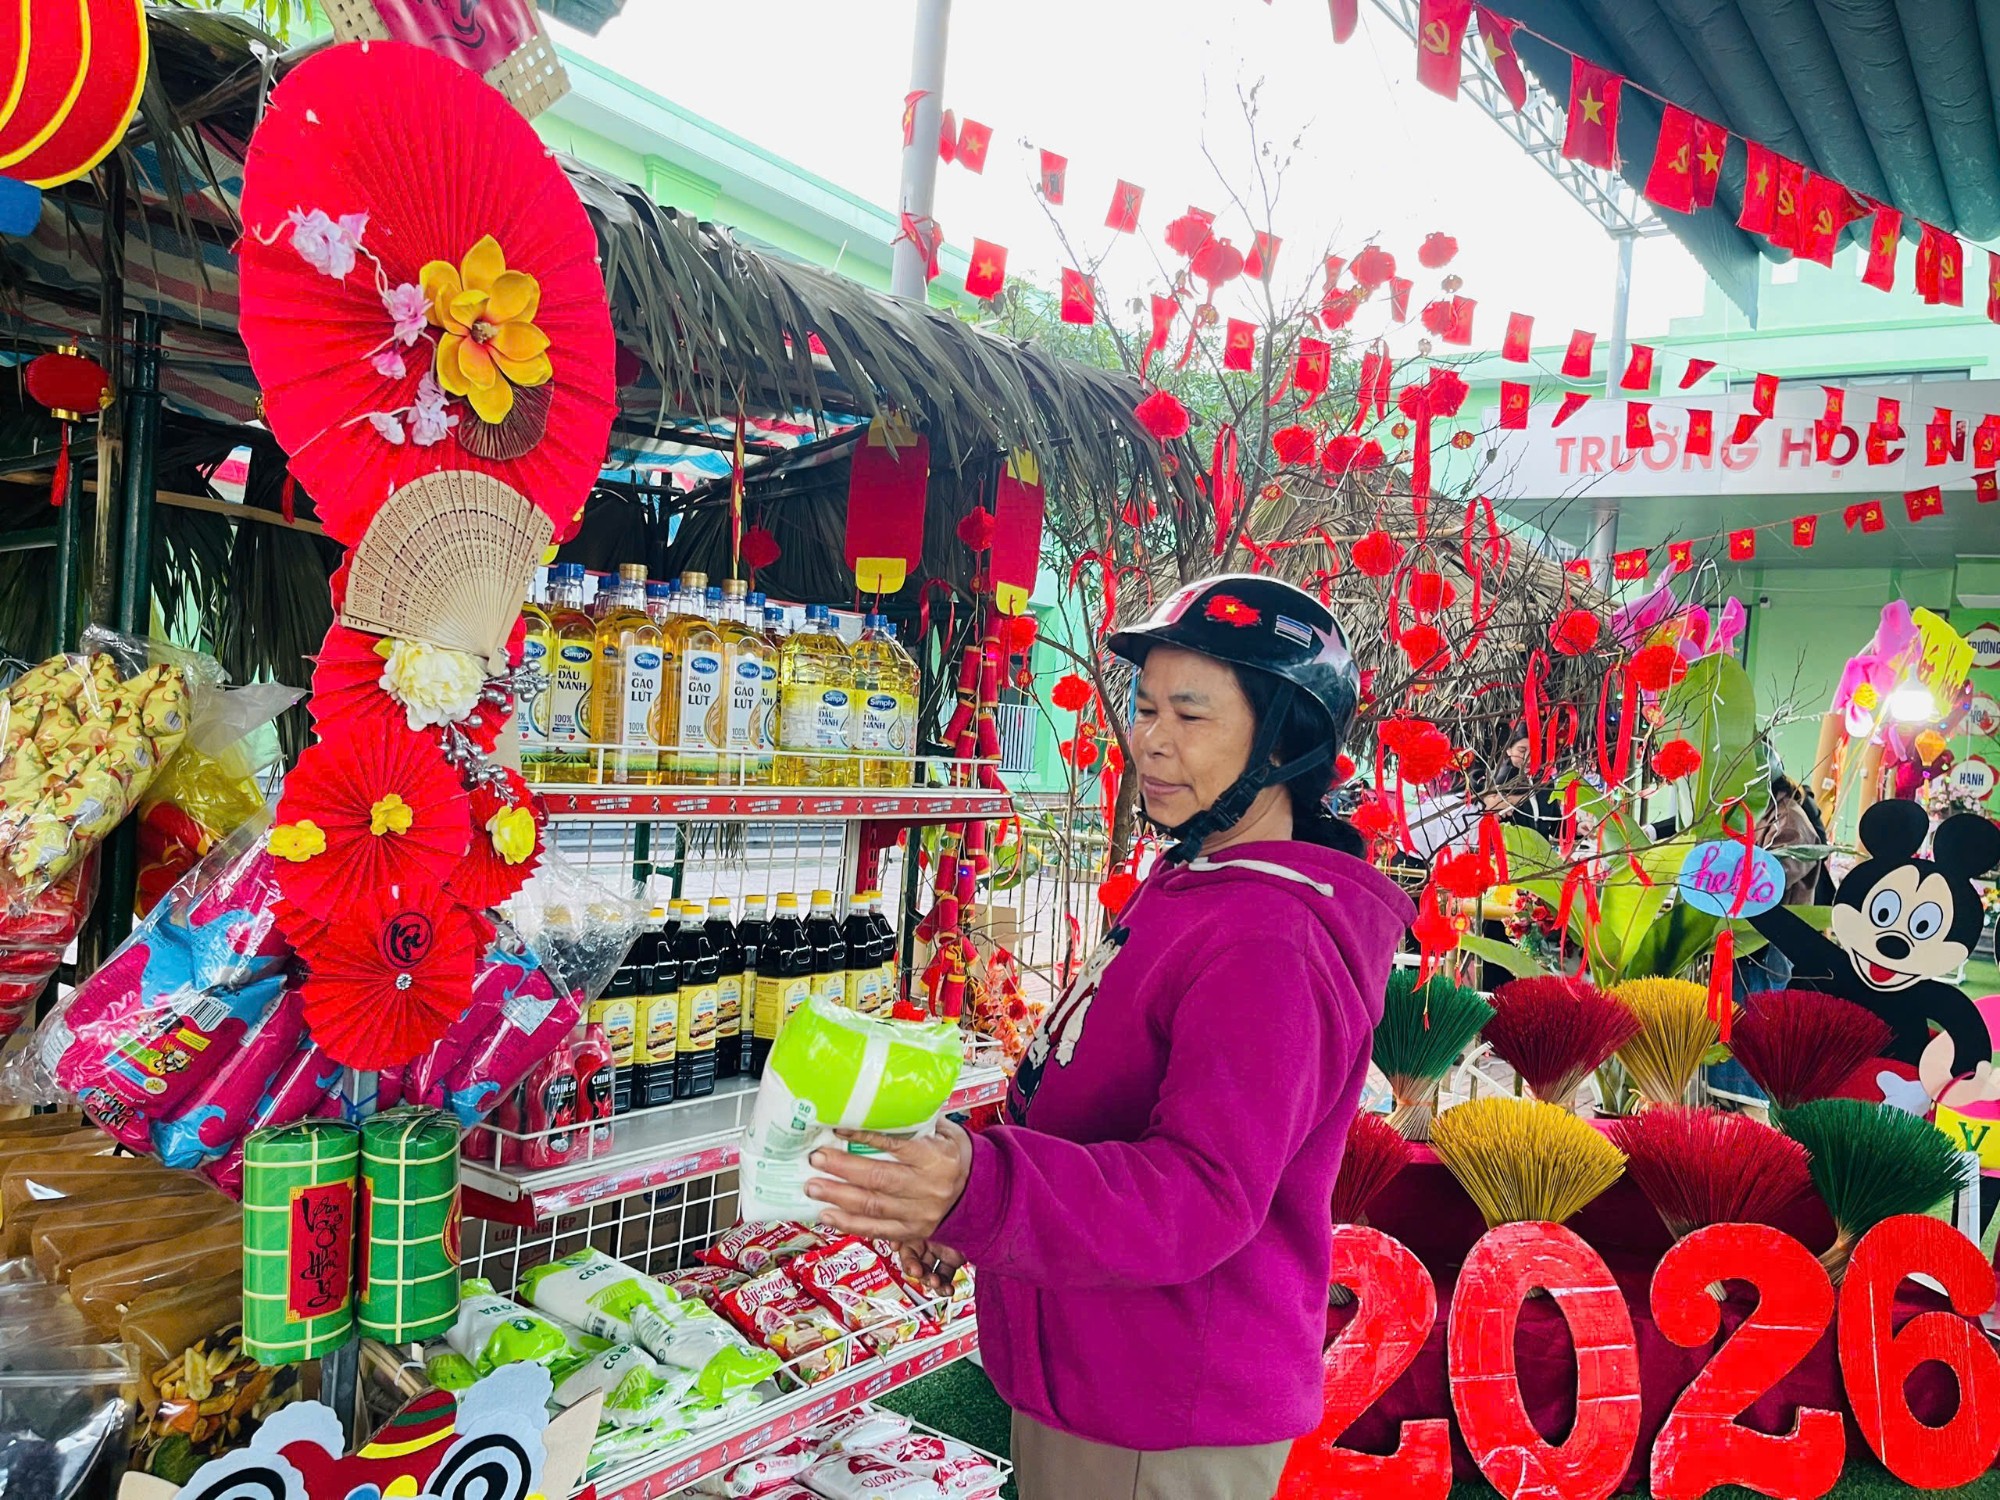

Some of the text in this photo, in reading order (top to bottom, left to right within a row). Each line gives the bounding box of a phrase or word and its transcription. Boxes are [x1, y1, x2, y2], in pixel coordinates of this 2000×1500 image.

[564, 649, 591, 660] Simply
[636, 656, 659, 667] Simply
[693, 660, 718, 672] Simply
[739, 665, 759, 675] Simply
[824, 694, 846, 705] Simply
[870, 698, 896, 708] Simply
[554, 714, 572, 724] 100%
[629, 722, 645, 731] 100%
[686, 725, 702, 734] 100%
[732, 728, 746, 736] 100%
[1690, 845, 1775, 904] hello
[549, 1081, 577, 1095] CHIN-SU
[1280, 1213, 2000, 1500] 2026
